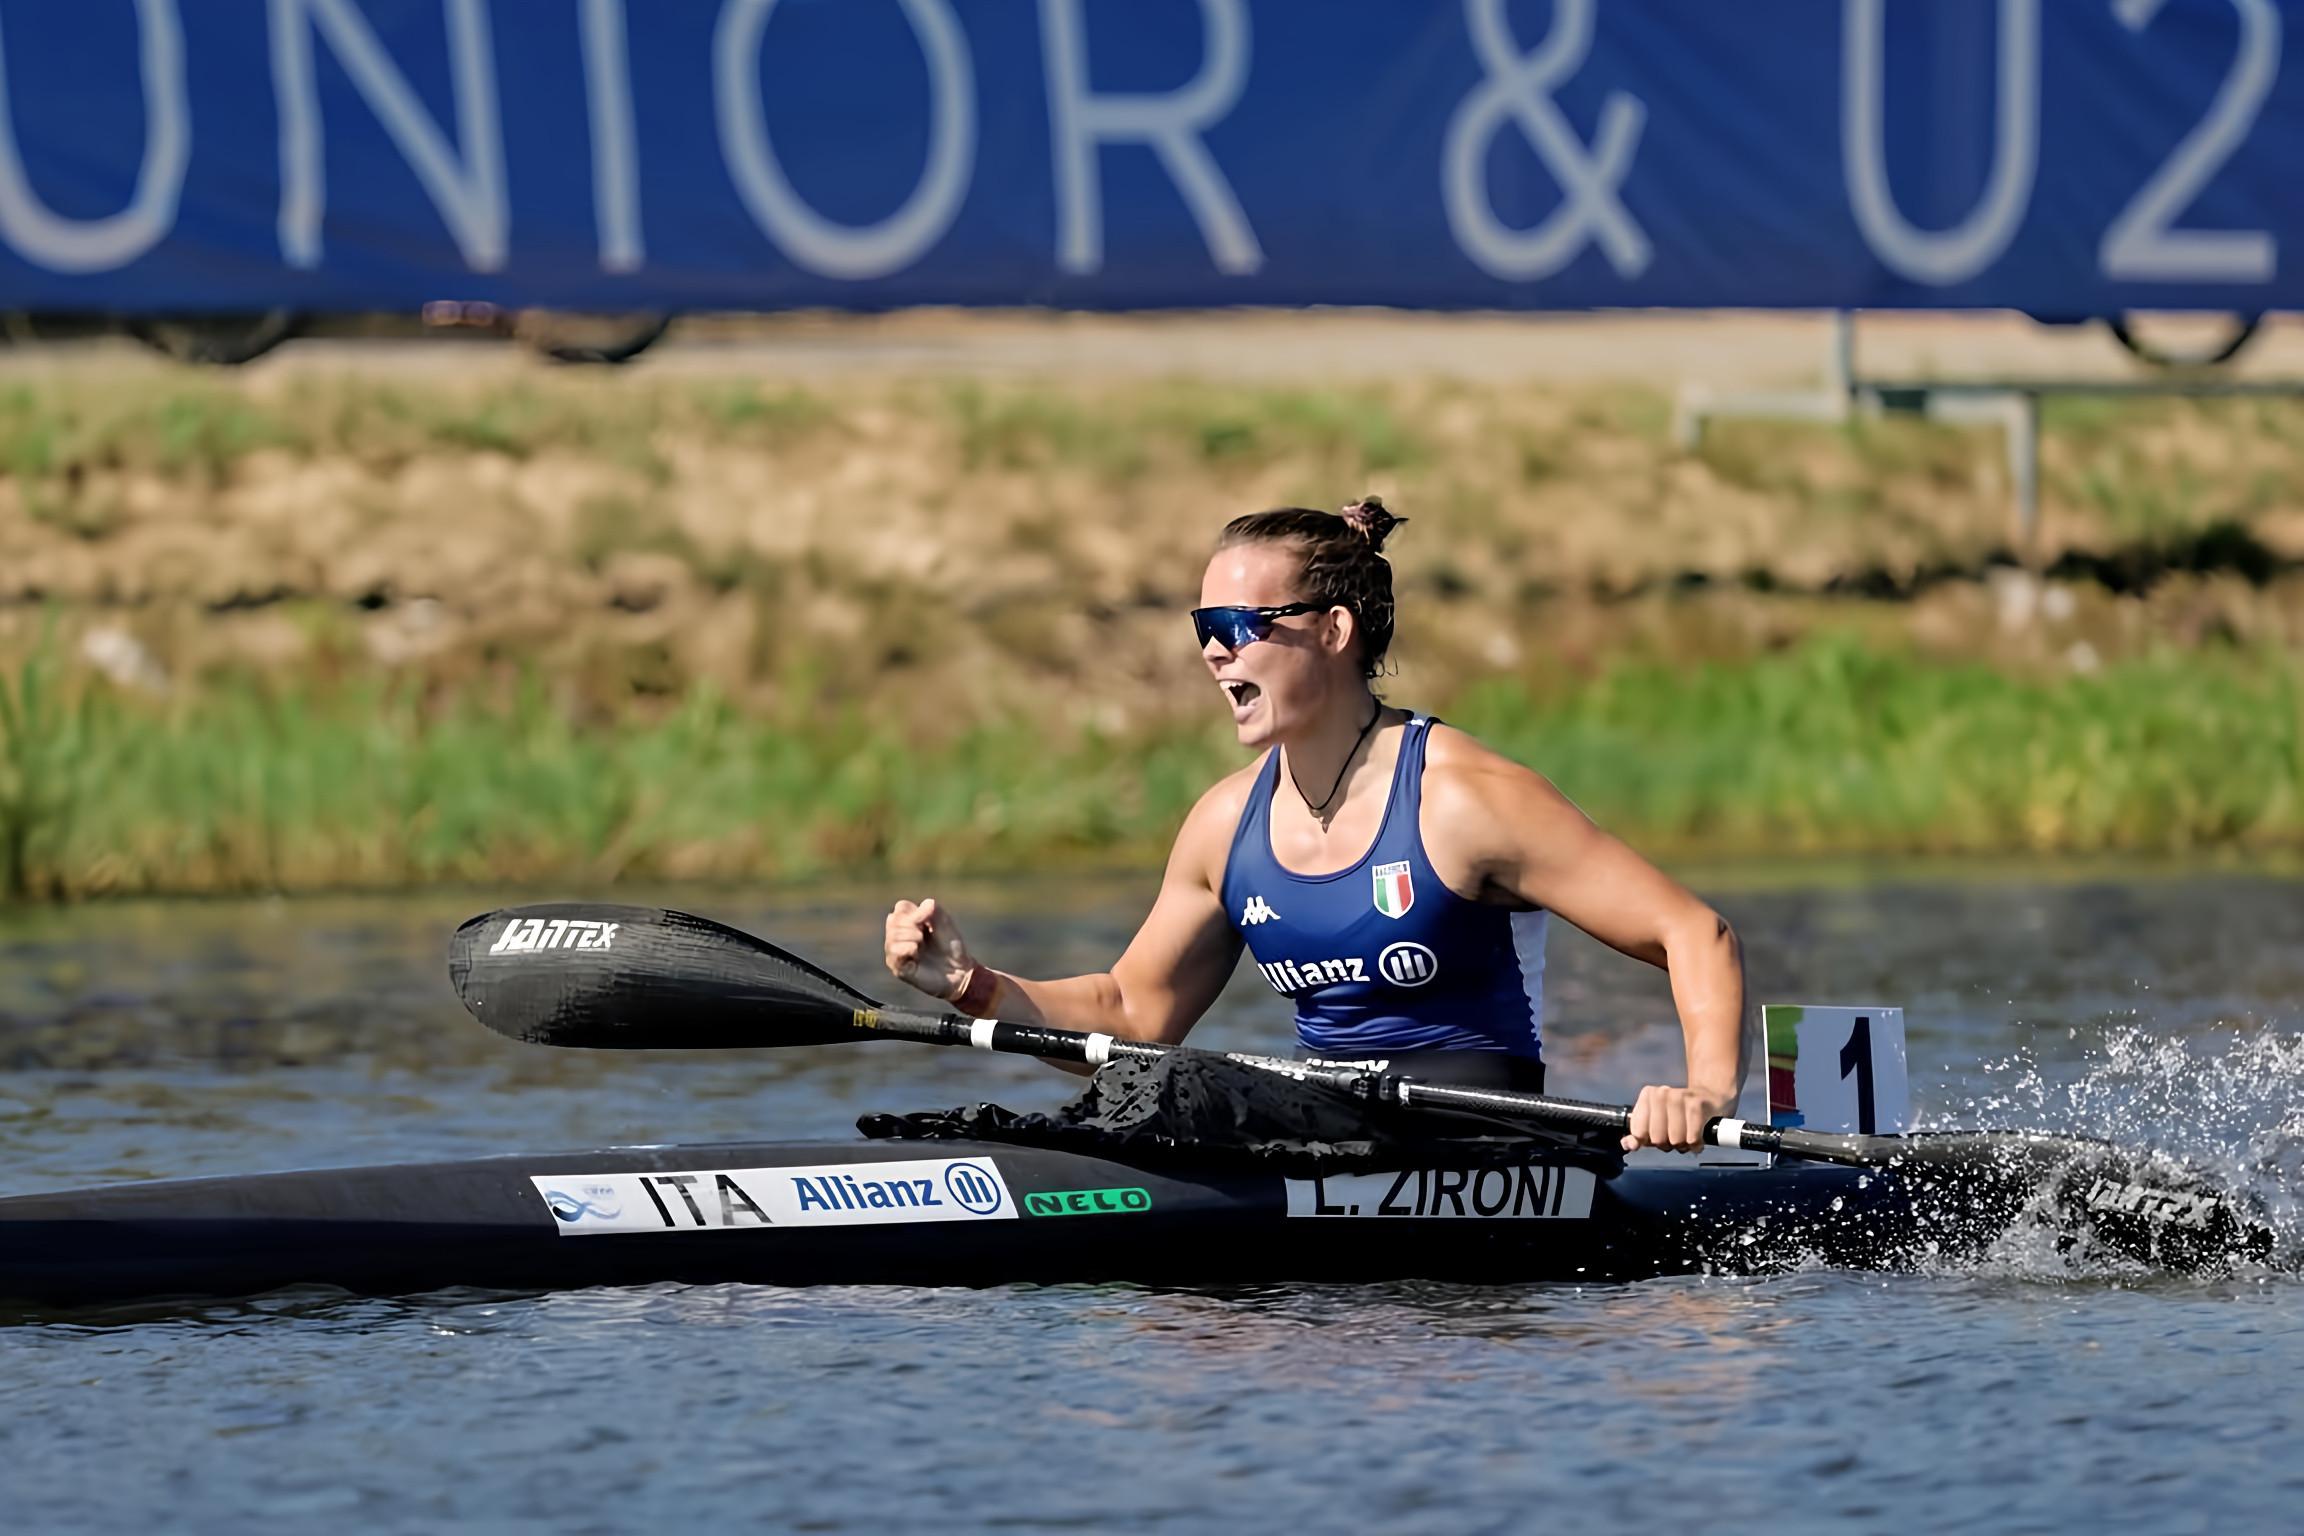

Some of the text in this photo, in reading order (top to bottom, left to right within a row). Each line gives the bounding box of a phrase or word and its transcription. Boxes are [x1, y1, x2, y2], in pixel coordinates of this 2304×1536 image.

[1441, 0, 1653, 281] &
[1841, 0, 2281, 285] U2
[489, 918, 620, 955] JANTEX
[1257, 958, 1371, 993] llianz
[1839, 1016, 1876, 1135] 1
[638, 1174, 943, 1227] ITA Allianz
[1029, 1189, 1148, 1214] NELO
[1314, 1165, 1566, 1217] L. ZIRONI
